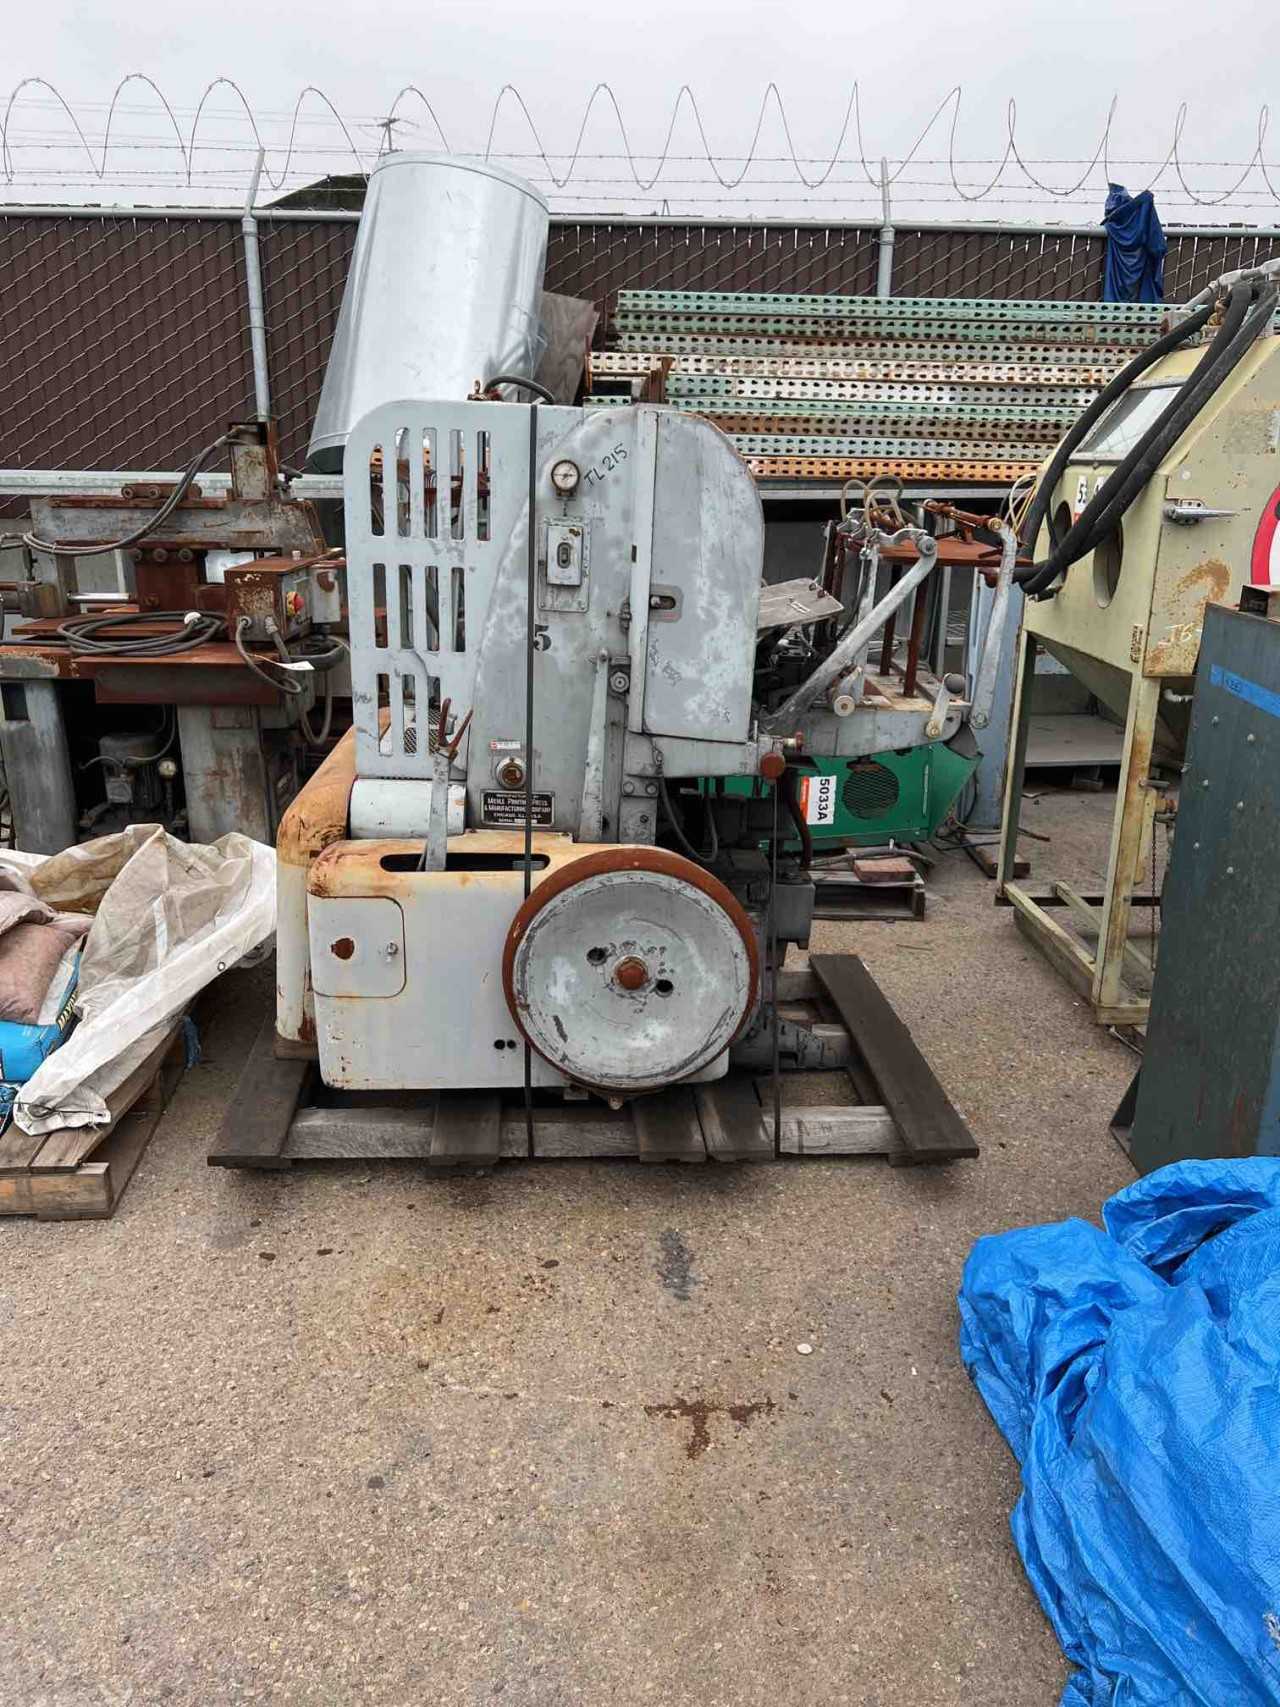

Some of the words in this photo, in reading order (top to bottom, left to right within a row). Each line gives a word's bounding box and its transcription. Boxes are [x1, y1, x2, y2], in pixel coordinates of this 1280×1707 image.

[584, 468, 605, 488] TL
[602, 442, 628, 471] 215
[534, 623, 552, 651] 5
[817, 778, 830, 821] 5033A
